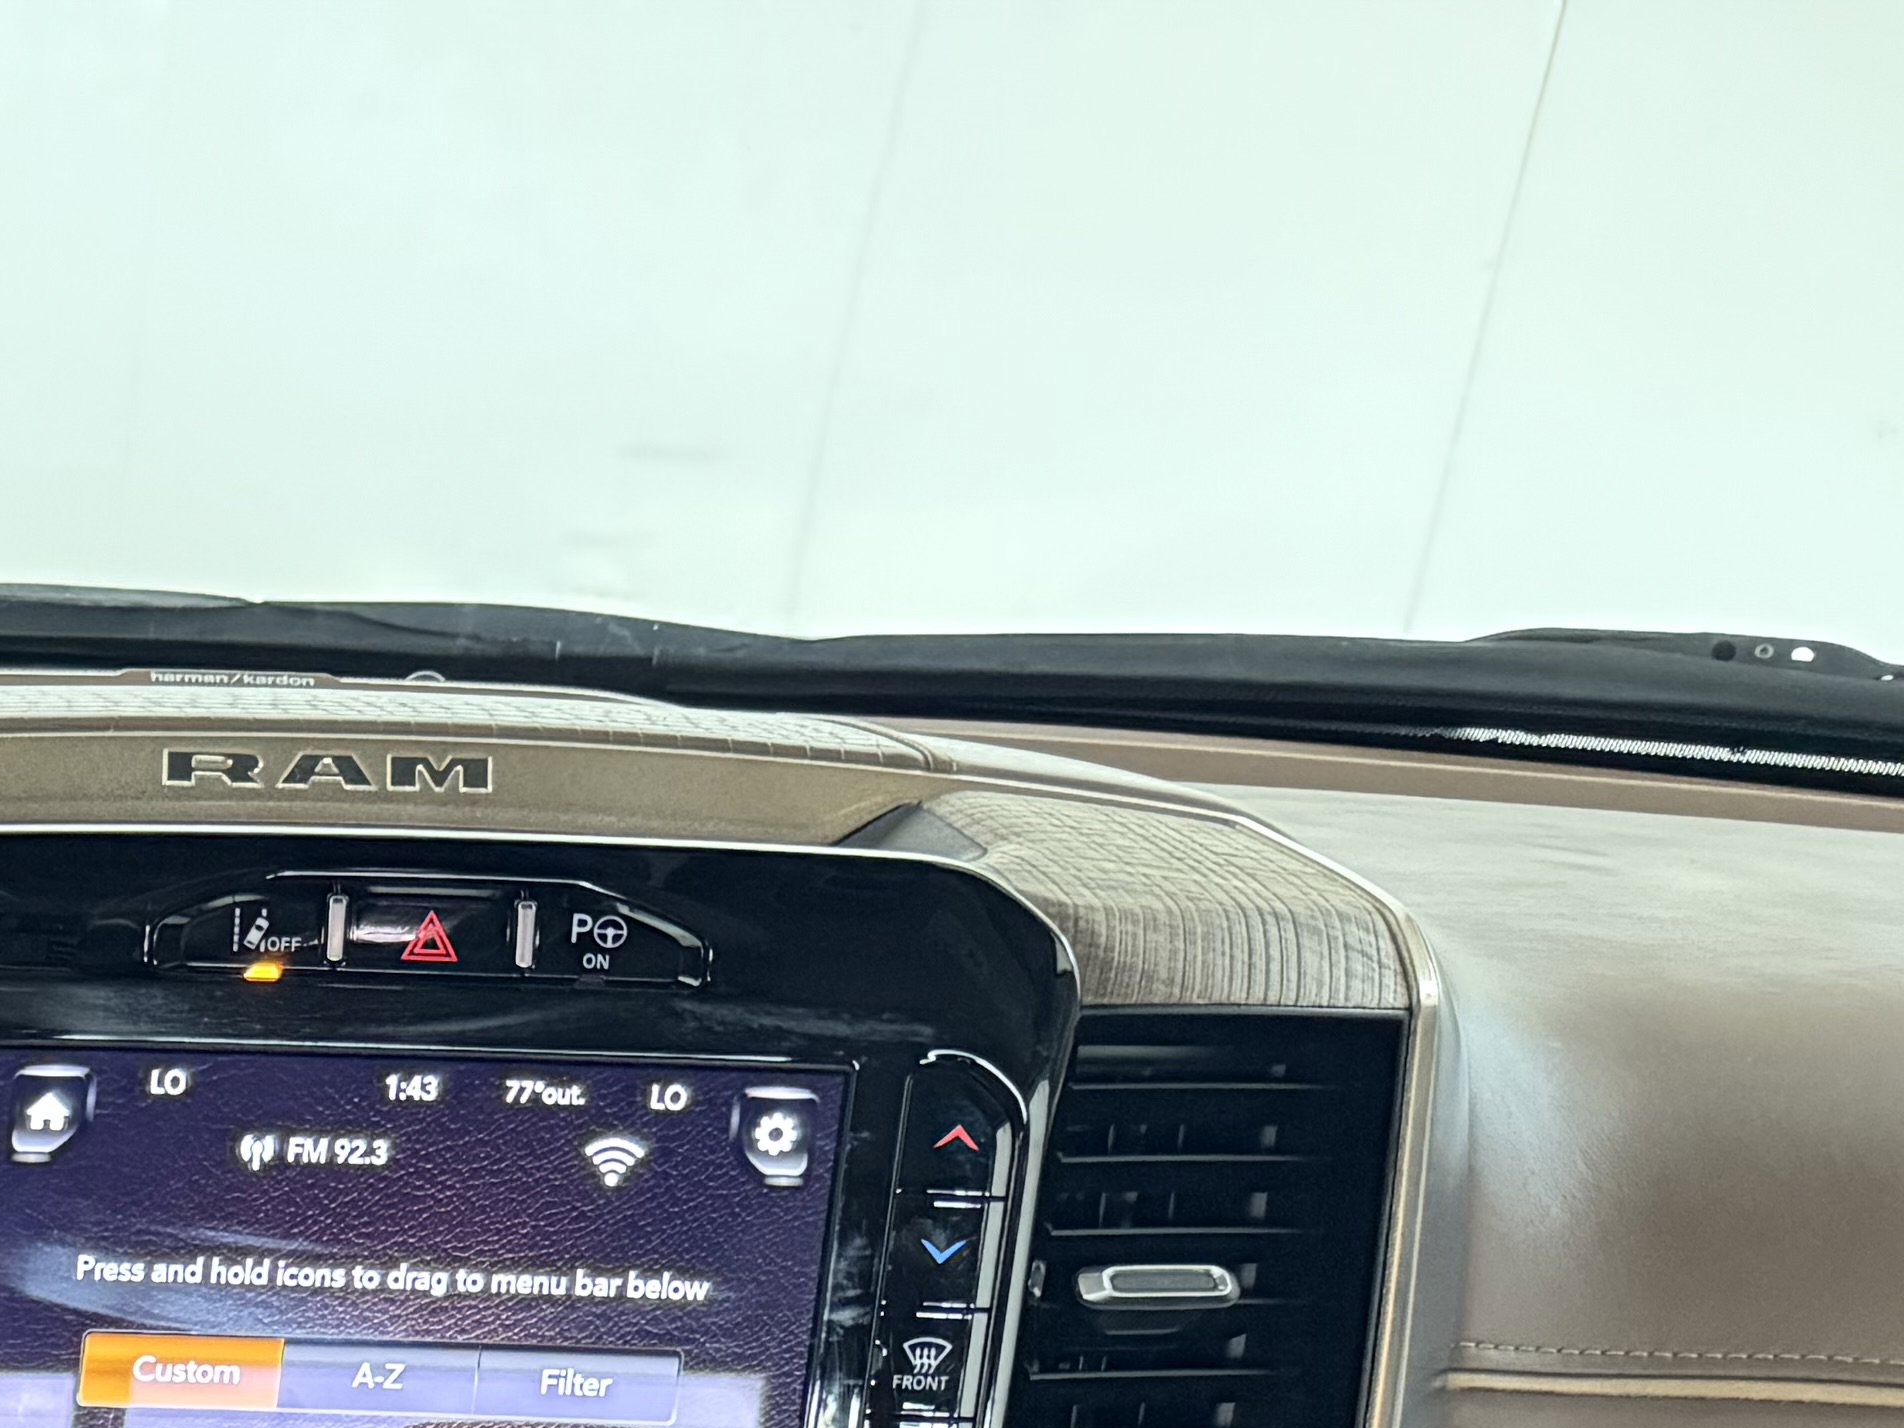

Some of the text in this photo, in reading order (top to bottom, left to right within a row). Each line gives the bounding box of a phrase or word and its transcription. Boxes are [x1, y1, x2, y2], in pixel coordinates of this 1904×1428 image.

[150, 671, 315, 687] harman/kardon
[161, 749, 493, 794] RAM
[266, 936, 302, 952] OFF
[582, 954, 610, 970] ON
[149, 1069, 187, 1096] LO
[385, 1074, 439, 1102] 1:43
[650, 1084, 688, 1111] LO
[287, 1137, 388, 1165] FM 92.3
[76, 1253, 712, 1301] Press and hold icons to drag to menu bar below
[132, 1355, 241, 1385] Custom
[351, 1362, 407, 1390] A-Z
[540, 1368, 614, 1398] Filter
[892, 1374, 950, 1391] FRONT
